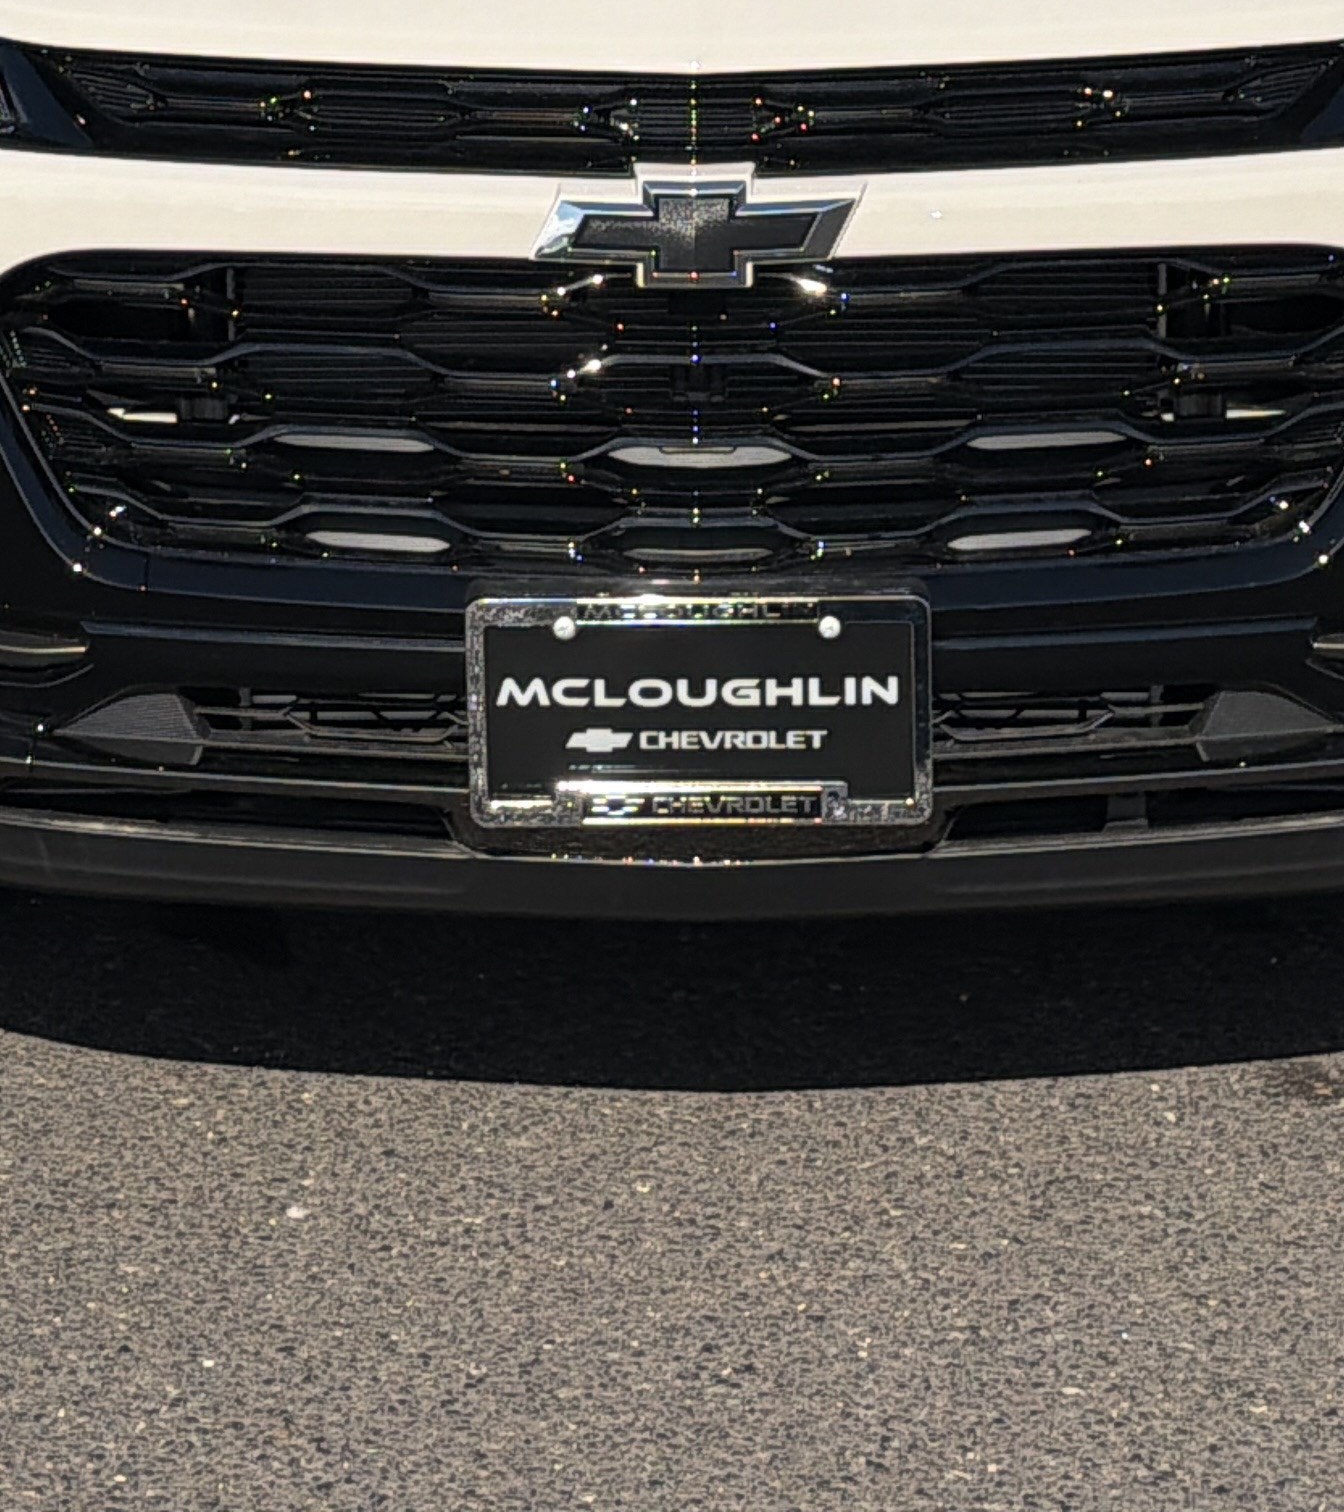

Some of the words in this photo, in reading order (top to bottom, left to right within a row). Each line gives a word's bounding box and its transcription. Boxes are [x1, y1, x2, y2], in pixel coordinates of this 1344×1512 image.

[497, 676, 899, 707] MCLOUGHLIN
[639, 730, 827, 749] CHEVROLET
[653, 796, 818, 814] CHEVROLET
